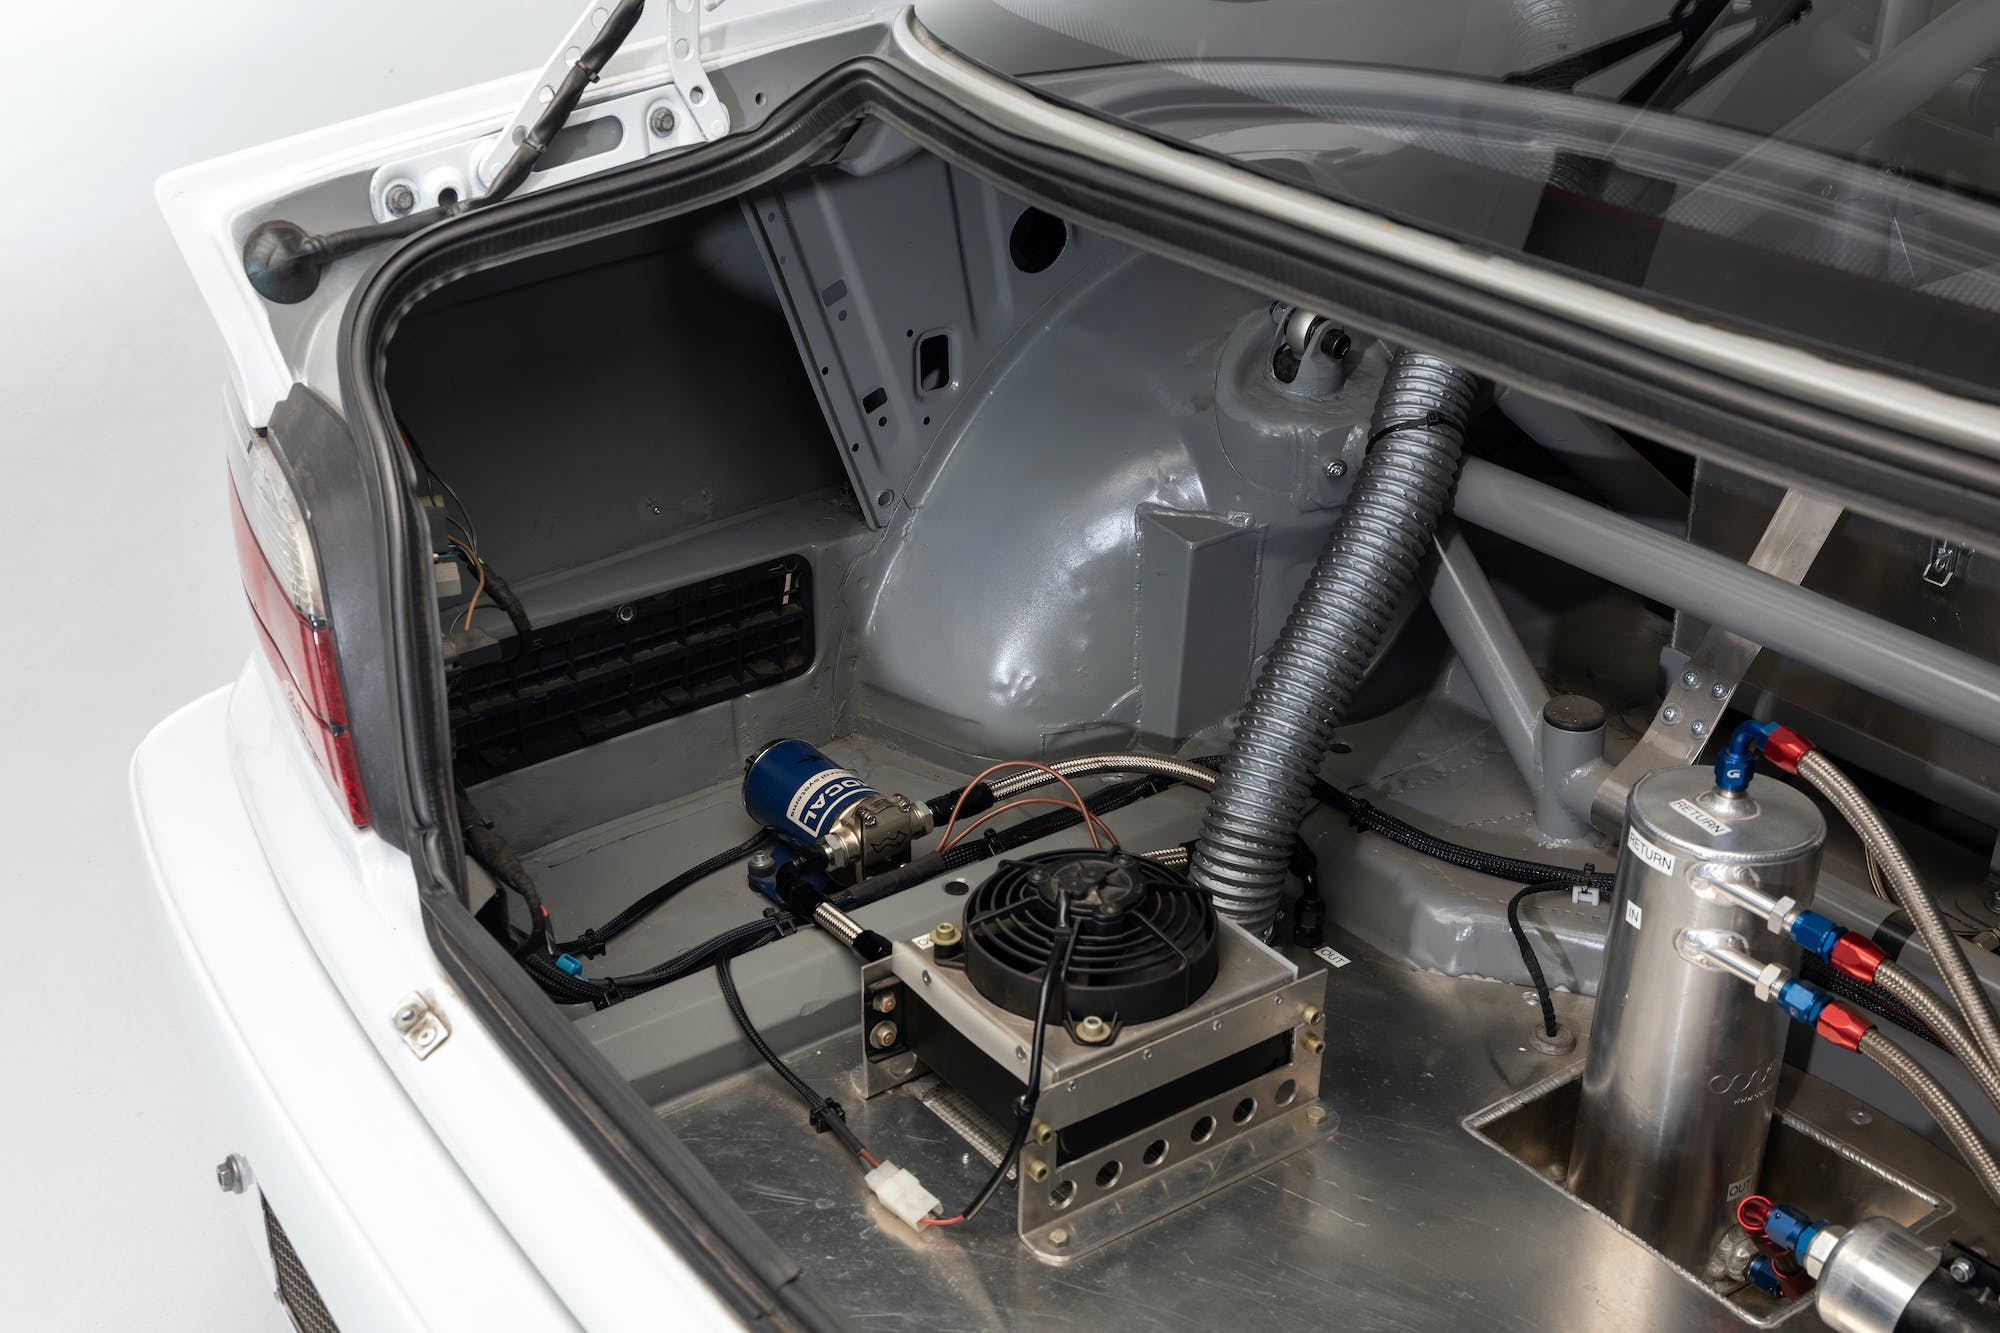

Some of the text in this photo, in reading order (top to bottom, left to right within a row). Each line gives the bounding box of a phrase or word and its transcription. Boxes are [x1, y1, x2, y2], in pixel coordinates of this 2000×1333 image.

[803, 779, 867, 824] OCAL
[1674, 801, 1726, 833] RETURN
[1629, 833, 1672, 870] RETURN
[1629, 907, 1639, 923] IN
[1321, 949, 1345, 964] OUT
